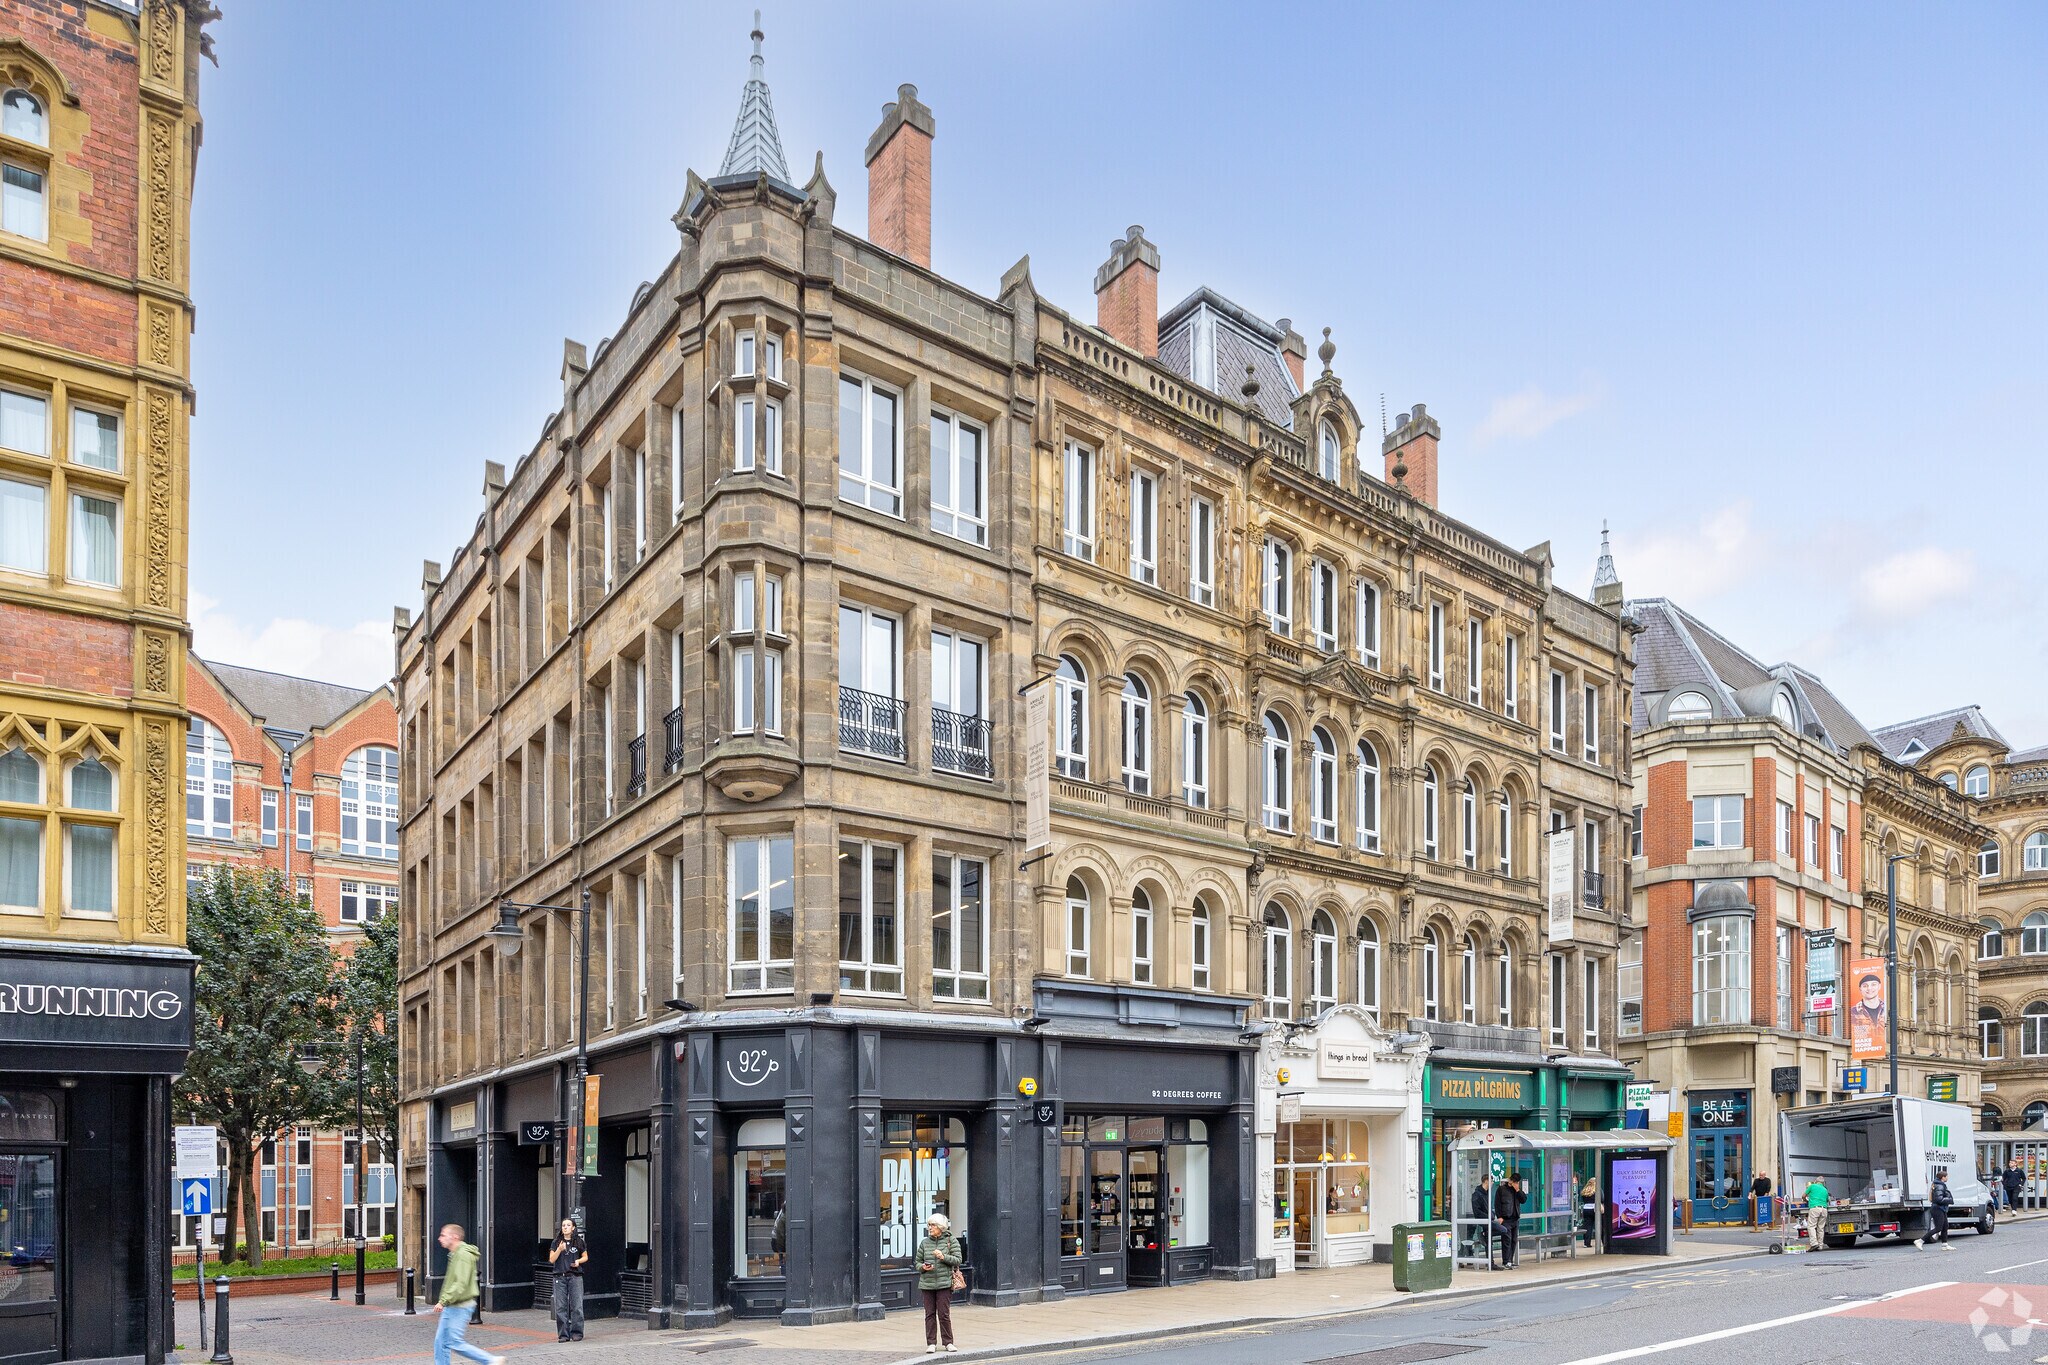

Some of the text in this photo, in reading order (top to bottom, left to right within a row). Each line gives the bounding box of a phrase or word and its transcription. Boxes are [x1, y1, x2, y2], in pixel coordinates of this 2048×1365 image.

[0, 982, 181, 1019] RUNNING
[1327, 1051, 1343, 1062] things
[1352, 1051, 1367, 1062] bread
[1163, 1090, 1194, 1098] DEGREES
[1196, 1091, 1222, 1099] COFFEE
[1441, 1079, 1472, 1098] PIZZA
[1702, 1100, 1733, 1110] BE AT
[1702, 1110, 1734, 1122] ONE
[882, 1158, 946, 1193] DAMN
[891, 1191, 937, 1225] FINE
